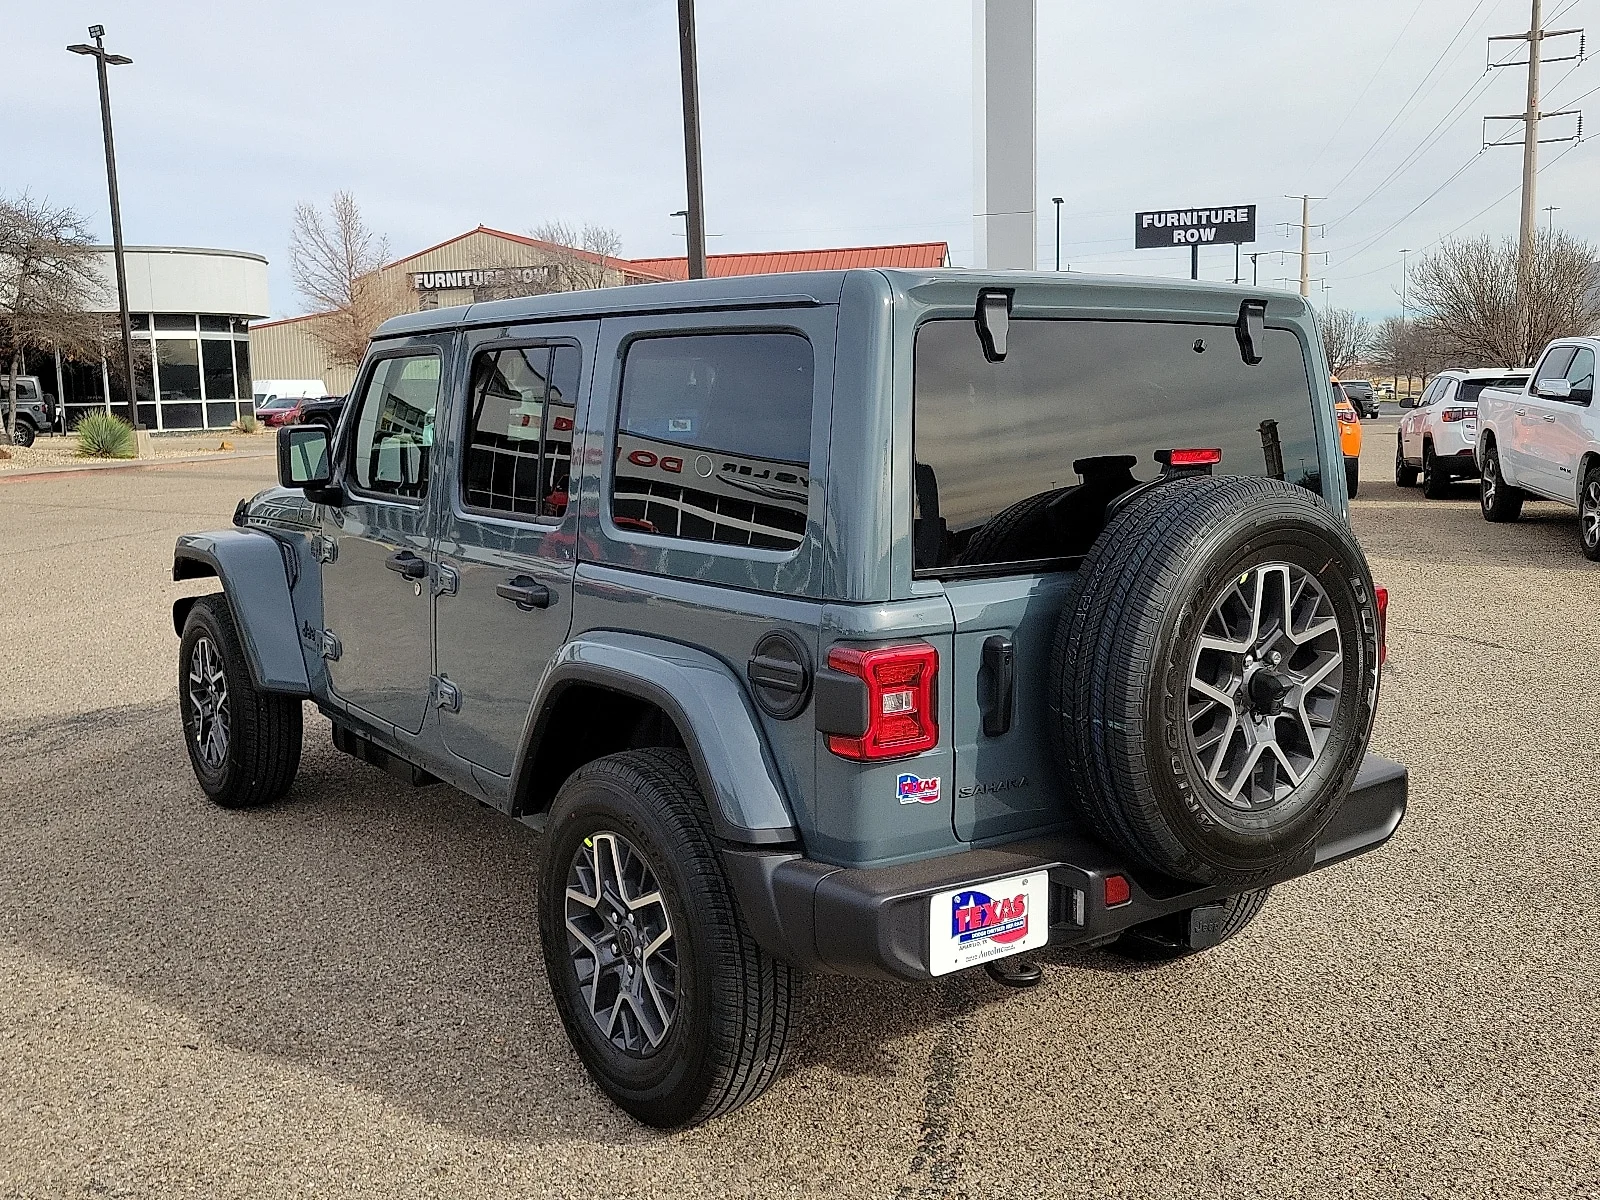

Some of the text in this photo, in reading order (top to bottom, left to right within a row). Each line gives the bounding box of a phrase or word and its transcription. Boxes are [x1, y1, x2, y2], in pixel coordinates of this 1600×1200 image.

[1142, 208, 1249, 228] FURNITURE
[1173, 228, 1217, 244] ROW
[1164, 561, 1218, 834] BRIDGESTONE
[901, 779, 937, 794] TEXAS
[958, 776, 1029, 799] SAHARA
[955, 893, 1025, 933] TEXAS
